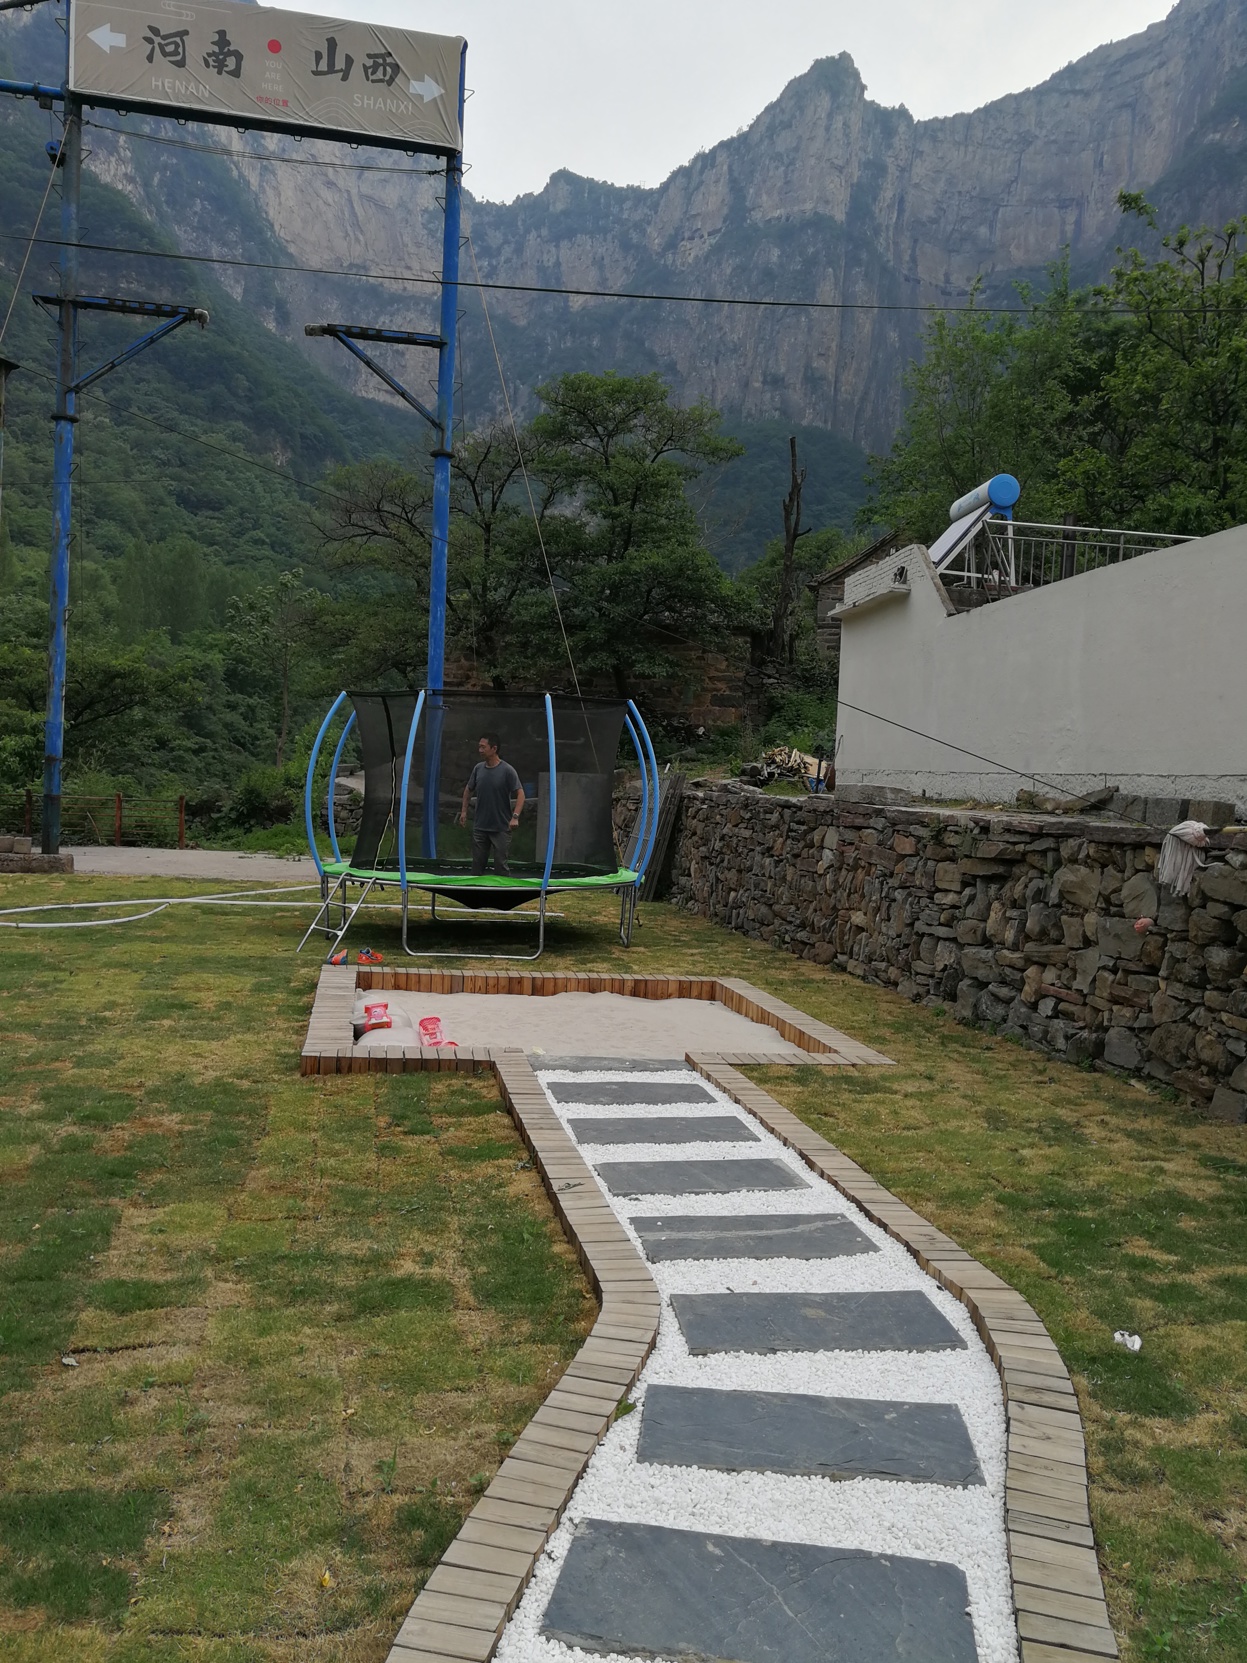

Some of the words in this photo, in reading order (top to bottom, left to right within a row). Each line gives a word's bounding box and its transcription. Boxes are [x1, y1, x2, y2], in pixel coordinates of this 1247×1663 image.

[142, 25, 244, 79] 河南
[311, 36, 401, 87] 山西
[265, 60, 283, 69] YOU
[152, 76, 210, 98] HENAN
[261, 82, 285, 92] HERE
[264, 72, 281, 81] ARE
[353, 93, 413, 115] SHANXI
